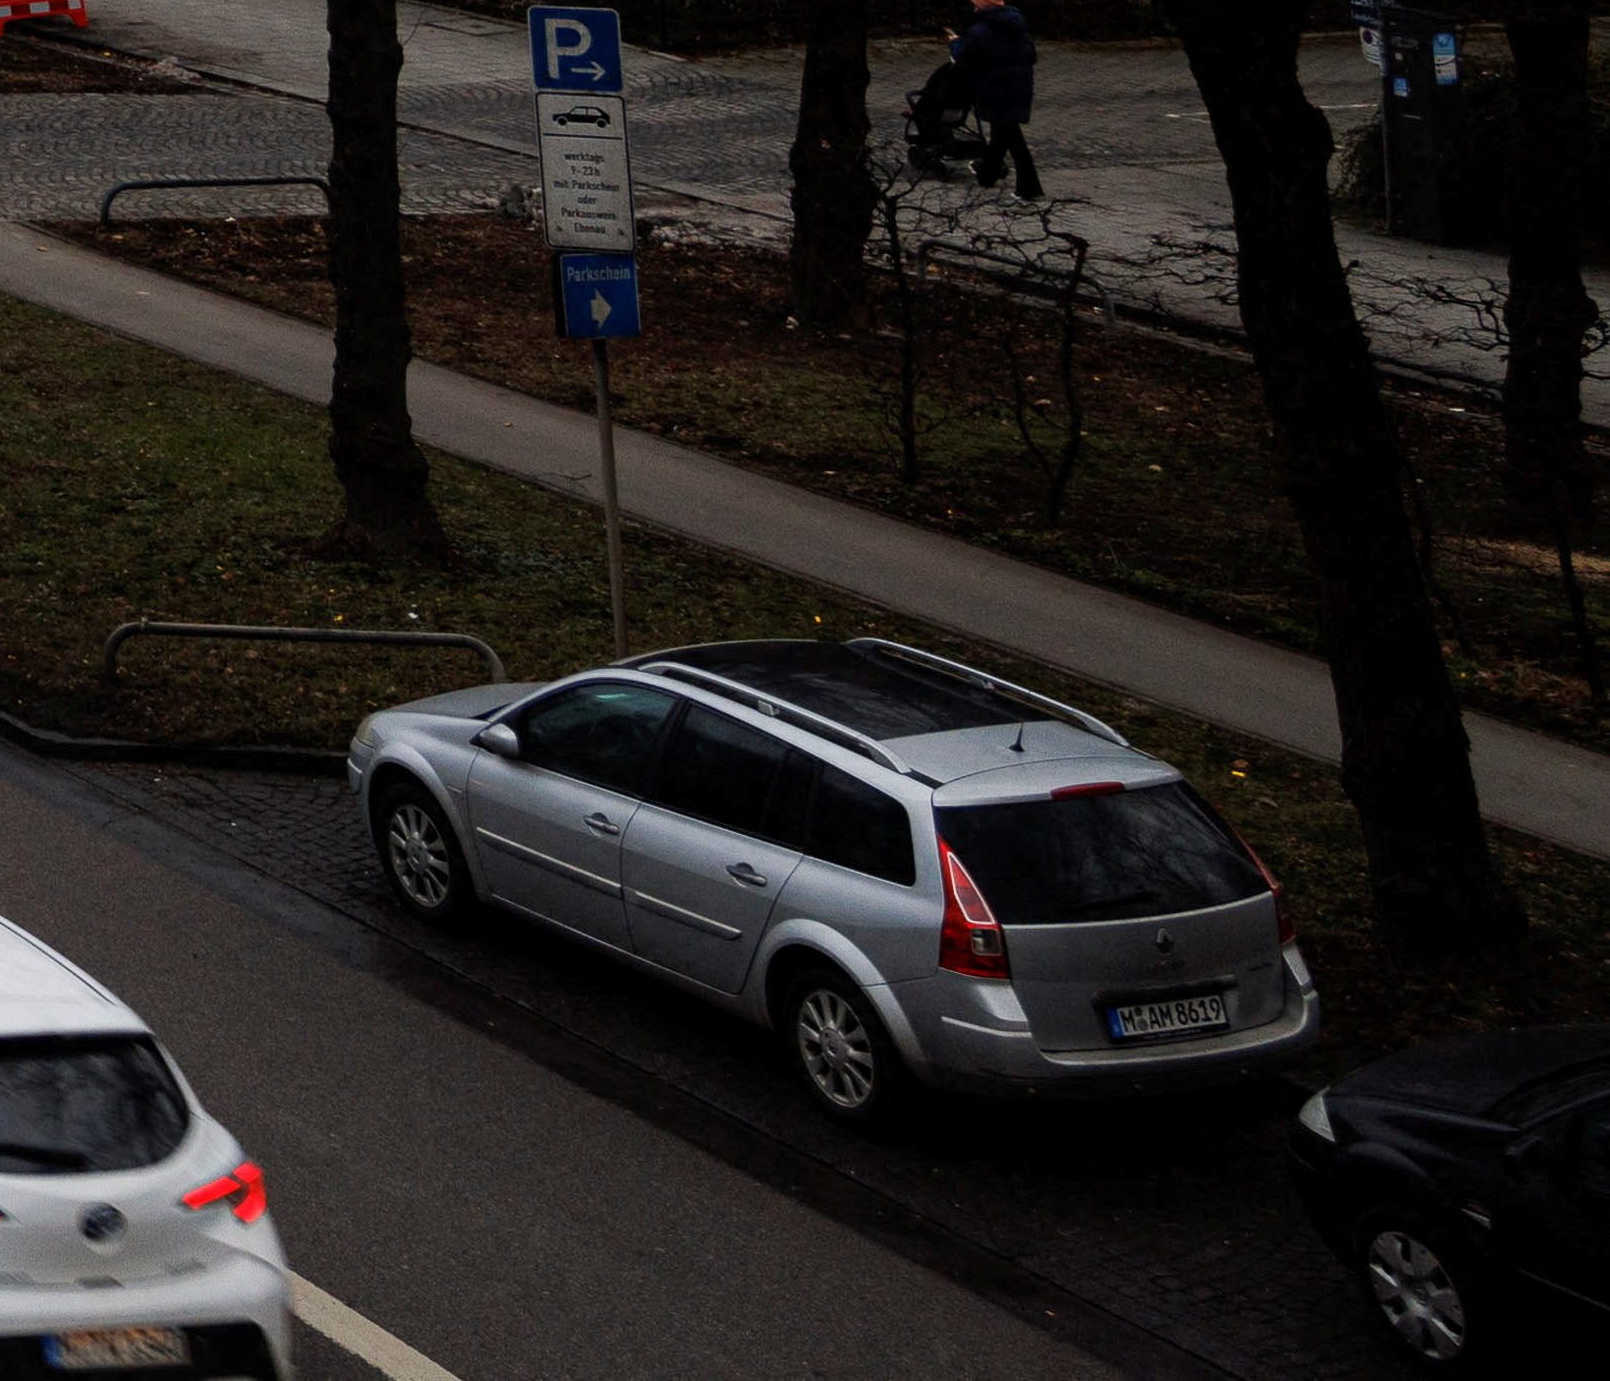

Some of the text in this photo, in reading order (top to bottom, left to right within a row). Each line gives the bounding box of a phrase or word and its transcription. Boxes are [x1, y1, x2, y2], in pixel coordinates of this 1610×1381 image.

[544, 18, 592, 79] P
[564, 152, 605, 164] werktags
[572, 180, 620, 192] Parkschein
[577, 194, 597, 204] oder
[566, 262, 631, 283] Parkschein
[1121, 997, 1221, 1032] M AM 8619
